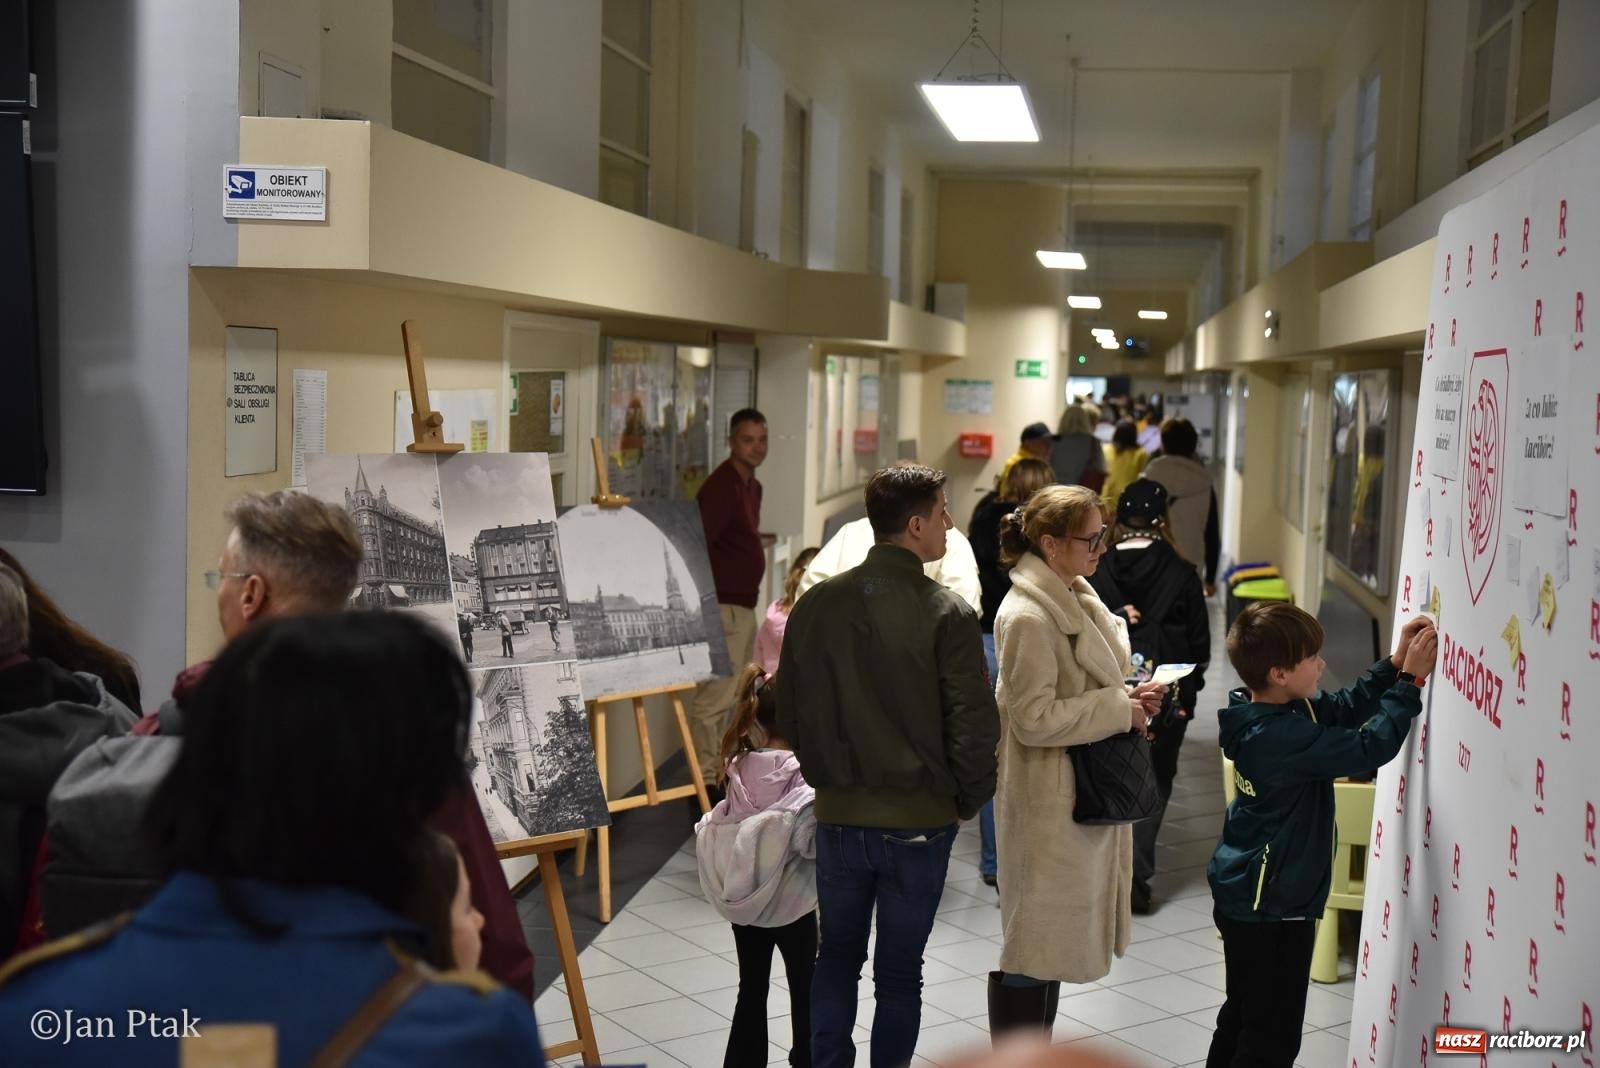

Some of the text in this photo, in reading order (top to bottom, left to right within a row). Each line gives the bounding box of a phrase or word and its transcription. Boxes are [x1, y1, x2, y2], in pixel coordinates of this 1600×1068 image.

[256, 188, 321, 198] MONITOROWANY
[269, 174, 308, 186] OBIEKT
[1523, 217, 1530, 253] R
[1559, 200, 1567, 238] R
[1468, 245, 1473, 274] R
[1492, 233, 1499, 265] R
[1445, 254, 1451, 282] R
[1534, 299, 1542, 336] R
[1575, 292, 1584, 333] R
[1429, 323, 1434, 349] R
[1451, 318, 1457, 347] R
[233, 372, 255, 382] TABLICA
[233, 399, 245, 409] SALI
[234, 415, 255, 424] KLIENTA
[1416, 450, 1423, 476] R
[1568, 488, 1578, 531] R
[1426, 518, 1433, 546] R
[1404, 575, 1411, 603] R
[1442, 632, 1503, 729] RACIBÓRZ
[1517, 652, 1526, 691] R
[1561, 681, 1571, 726] R
[1420, 724, 1427, 754] R
[1458, 740, 1471, 773] 1217
[1398, 775, 1405, 804] R
[1536, 758, 1545, 800] R
[1375, 820, 1382, 849] R
[1425, 806, 1432, 838] R
[1585, 801, 1596, 849] R
[1453, 843, 1460, 879] R
[1510, 824, 1518, 866] R
[1403, 854, 1411, 886] R
[1432, 894, 1439, 929] R
[1487, 886, 1495, 927] R
[1555, 872, 1565, 919] R
[1383, 900, 1390, 930] R
[1363, 940, 1369, 969] R
[1411, 941, 1419, 976] R
[1464, 941, 1472, 979] R
[1529, 938, 1538, 983] R
[1390, 983, 1397, 1016] R
[1443, 991, 1451, 1027] R
[1370, 1022, 1377, 1053] R
